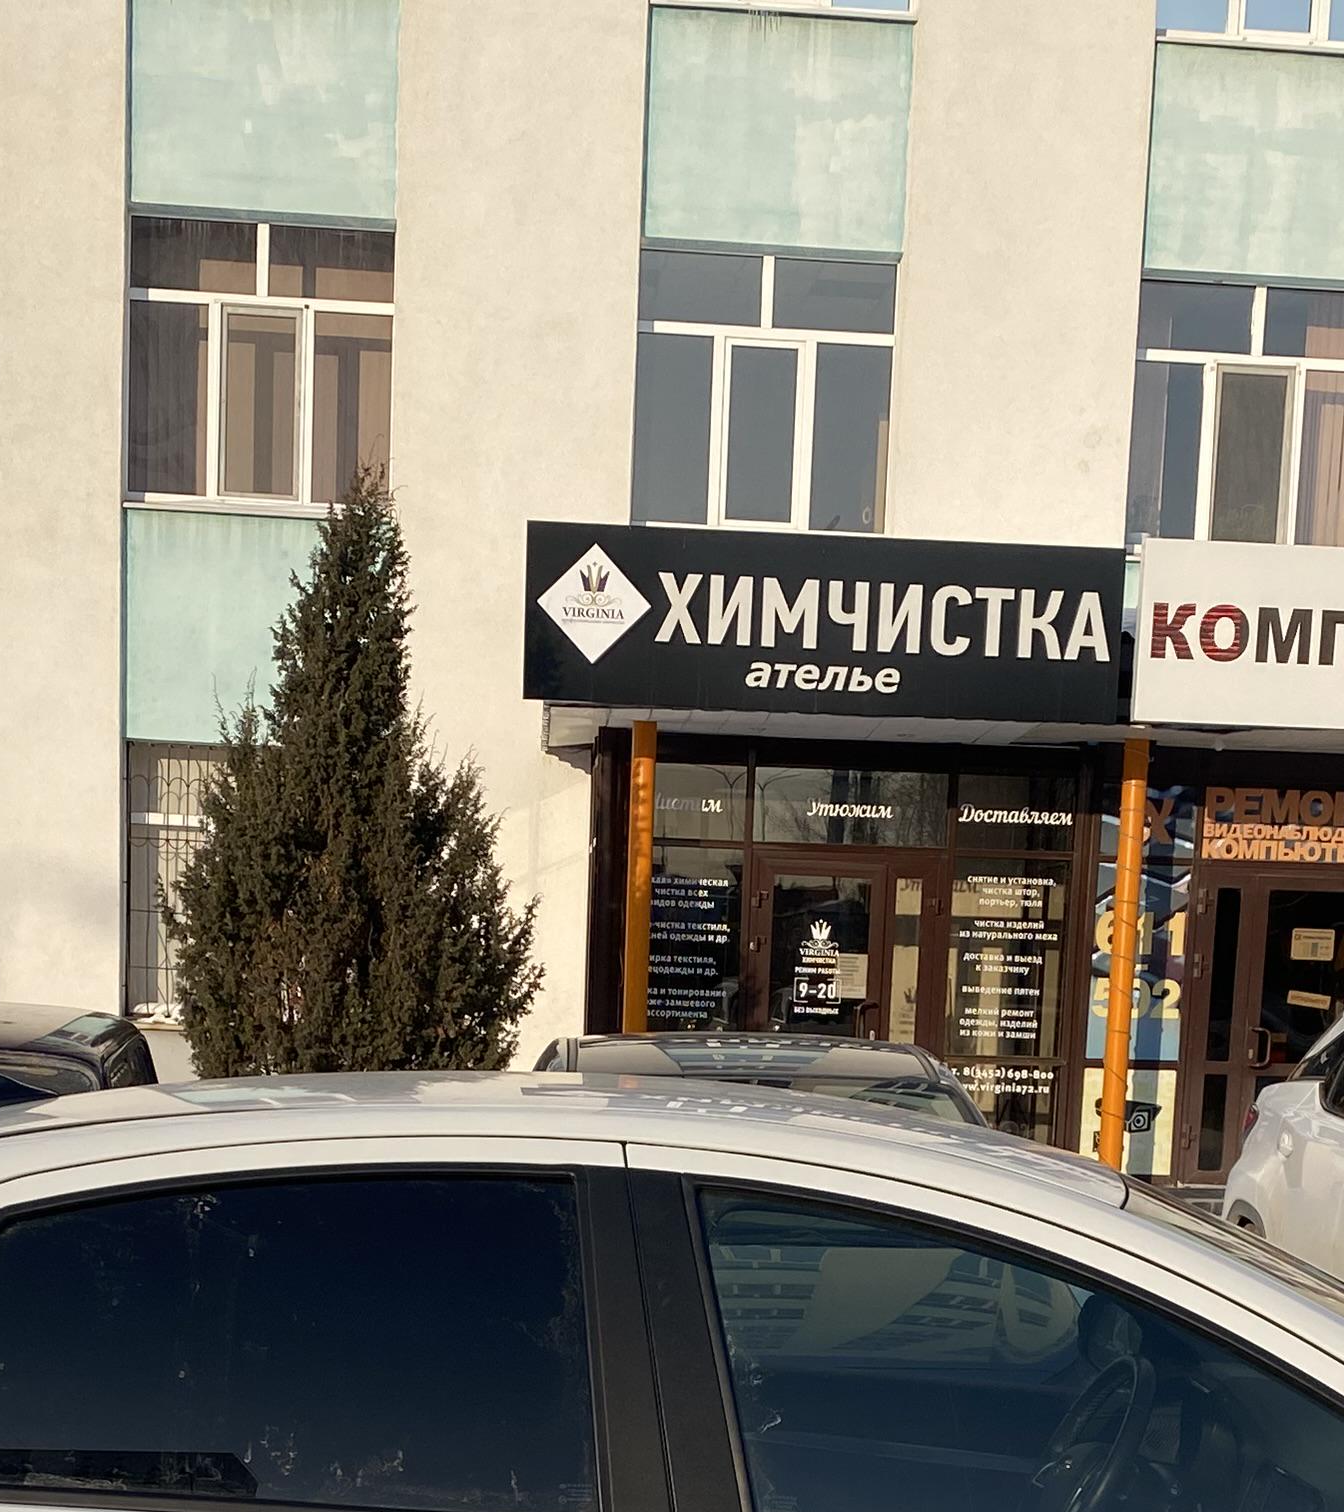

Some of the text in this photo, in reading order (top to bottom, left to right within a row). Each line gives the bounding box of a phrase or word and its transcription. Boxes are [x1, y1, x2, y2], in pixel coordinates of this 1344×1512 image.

[562, 606, 624, 620] VIRGINIA
[655, 571, 1111, 663] ХИМЧИСТКА
[745, 657, 902, 694] ателье
[807, 799, 894, 819] Утюжим
[958, 803, 1073, 826] Доставляем
[673, 878, 729, 888] химическая
[967, 875, 998, 884] снятие
[1008, 877, 1056, 887] установка,
[655, 888, 709, 898] чистка всех
[983, 887, 1013, 896] чистка
[678, 900, 715, 910] одежды
[1021, 899, 1043, 908] тюля
[688, 922, 731, 933] текстиля,
[974, 920, 1045, 930] чистка изделий
[669, 932, 707, 942] одежды
[959, 930, 1058, 941] из натурального меха
[799, 948, 840, 957] VIRGINIA
[673, 955, 717, 966] текстиля,
[963, 953, 1005, 962] доставка
[1014, 956, 1043, 965] выезд
[984, 966, 1030, 975] заказчику
[667, 988, 727, 998] тонирование
[961, 985, 1041, 996] выведение пятен
[964, 1007, 1034, 1018] мелкий ремонт
[999, 1019, 1038, 1029] изделий
[959, 1029, 971, 1037] из
[972, 1030, 997, 1038] кожи
[1005, 1031, 1037, 1040] замши
[963, 1067, 1054, 1080] 8(3452)698-800
